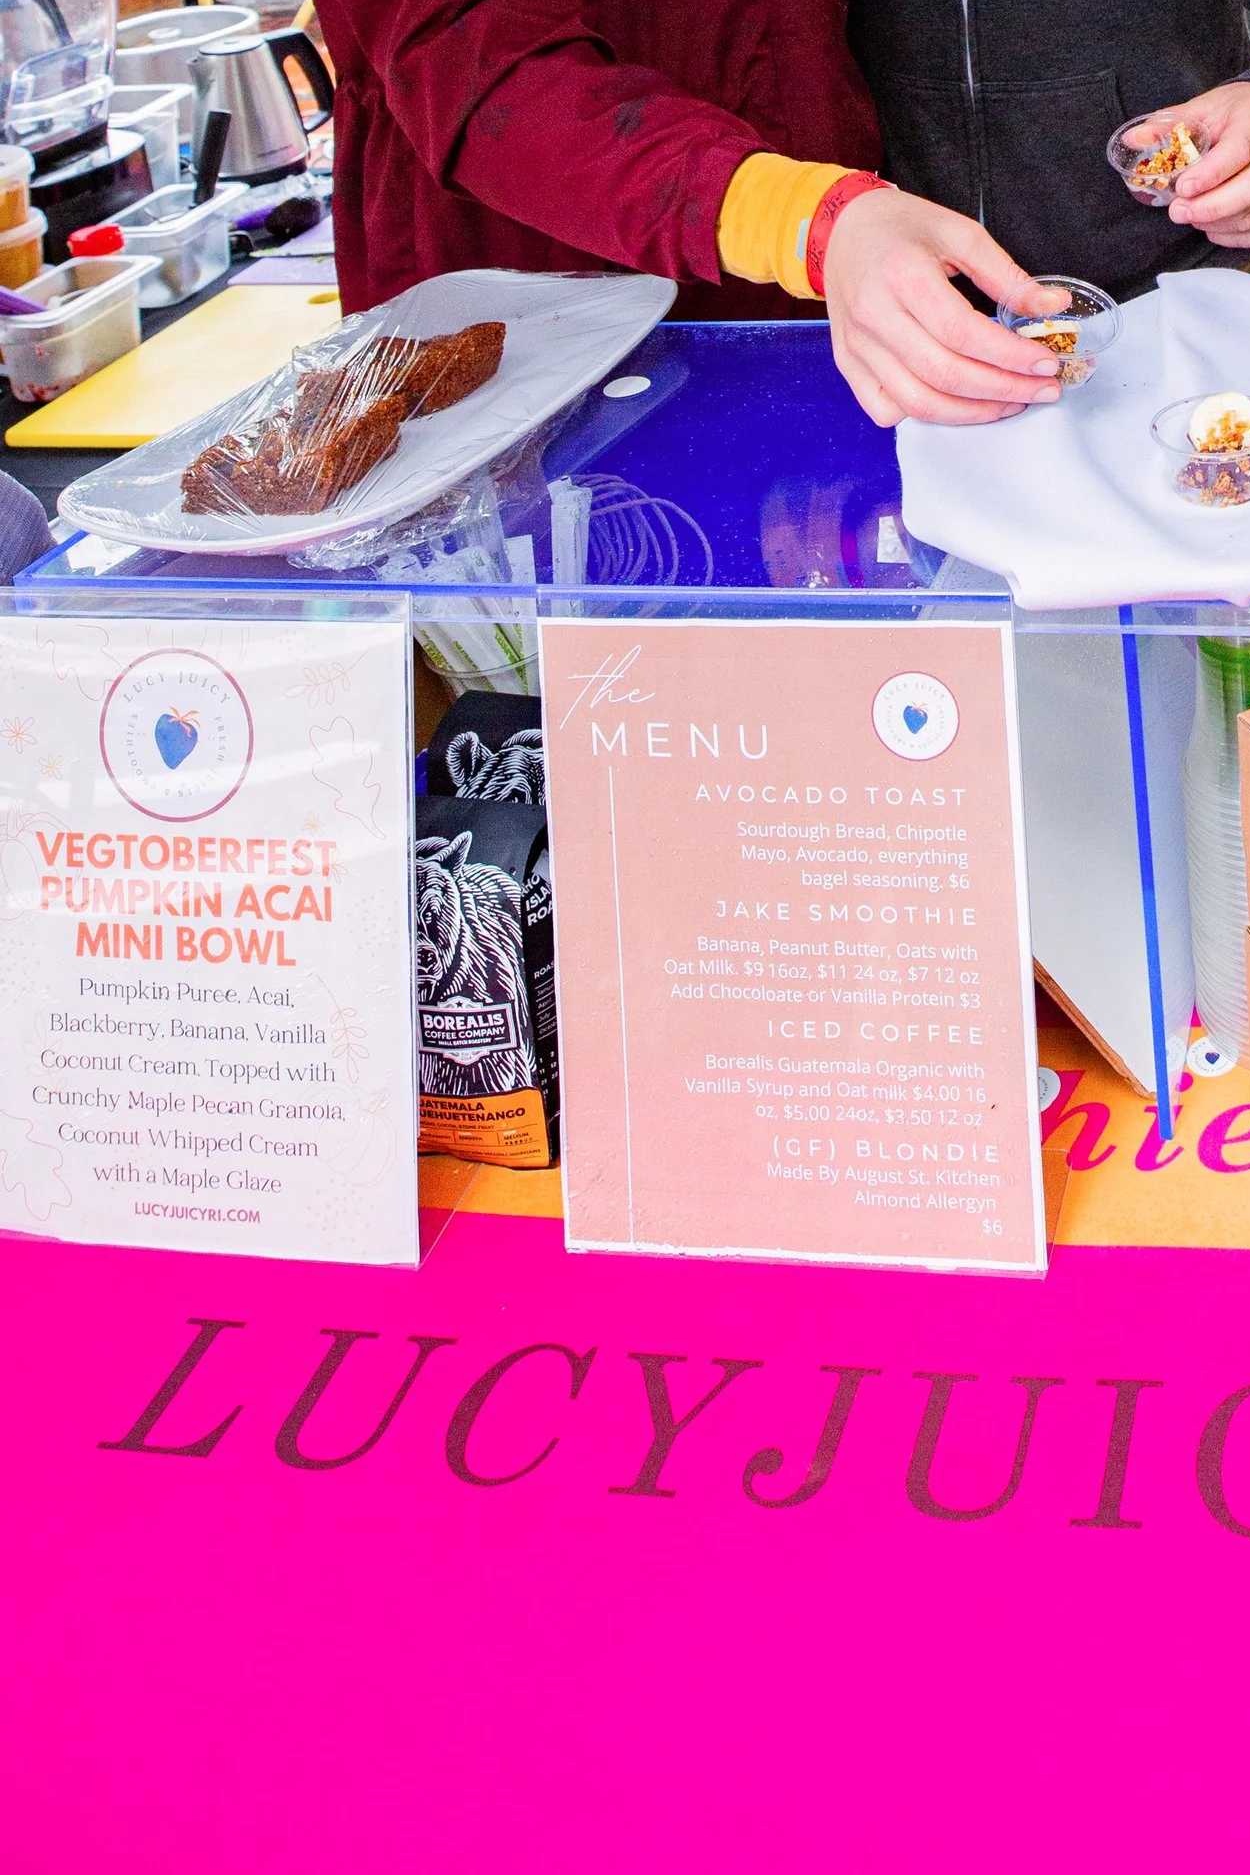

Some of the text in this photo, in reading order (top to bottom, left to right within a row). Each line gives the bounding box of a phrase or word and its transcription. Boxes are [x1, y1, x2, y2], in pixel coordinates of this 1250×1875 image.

[123, 671, 230, 704] LUCY JUICY
[561, 644, 657, 729] the
[591, 723, 768, 761] MENU
[695, 784, 967, 807] AVOCADO TOAST
[738, 821, 967, 845] Sourdough Bread, Chipotle
[36, 830, 337, 879] VEGTOBERFEST
[741, 845, 969, 870] Mayo, Avocado, everything
[801, 869, 970, 892] bagel seasoning. $6
[41, 876, 333, 923] PUMPKIN ACAI
[716, 900, 977, 926] JAKE SMOOTHIE
[75, 924, 296, 967] MINI BOWL
[697, 935, 978, 962] Banana, Peanut Butter, Oats with
[664, 958, 979, 986] Oat Milk. $9 16oz, $11 24 oz, $7 12 oz
[79, 977, 295, 1010] Pumpkin Puree, Acai,
[671, 982, 981, 1010] Add Chocoloate or Vanilla Protein $3
[49, 1014, 326, 1046] Blackberry, Banana, Vanilla
[422, 1013, 504, 1031] BOREALIS
[425, 1027, 505, 1040] COFFEE COMPANY
[768, 1019, 983, 1045] ICED COFFEE
[40, 1050, 336, 1085] Coconut Cream, Topped with
[706, 1052, 984, 1082] Borealis Guatemala Organic with
[32, 1085, 120, 1113] Crunchy
[128, 1092, 186, 1117] Maple
[192, 1094, 253, 1117] Pecan
[685, 1077, 986, 1104] Vanilla Syrup and Oat milk $4.00 16
[756, 1103, 983, 1128] oz, $5.00 24oz, $3.50 12 oz
[58, 1123, 318, 1158] Coconut Whipped Cream
[773, 1138, 1000, 1163] (GF) BLONDIE
[94, 1162, 282, 1194] with a Maple Glaze
[767, 1161, 1000, 1188] Made By August St. Kitchen
[135, 1201, 260, 1225] LUCYJUICYRI.COM
[855, 1190, 996, 1214] Almond Allergyn
[982, 1217, 1002, 1236] $6
